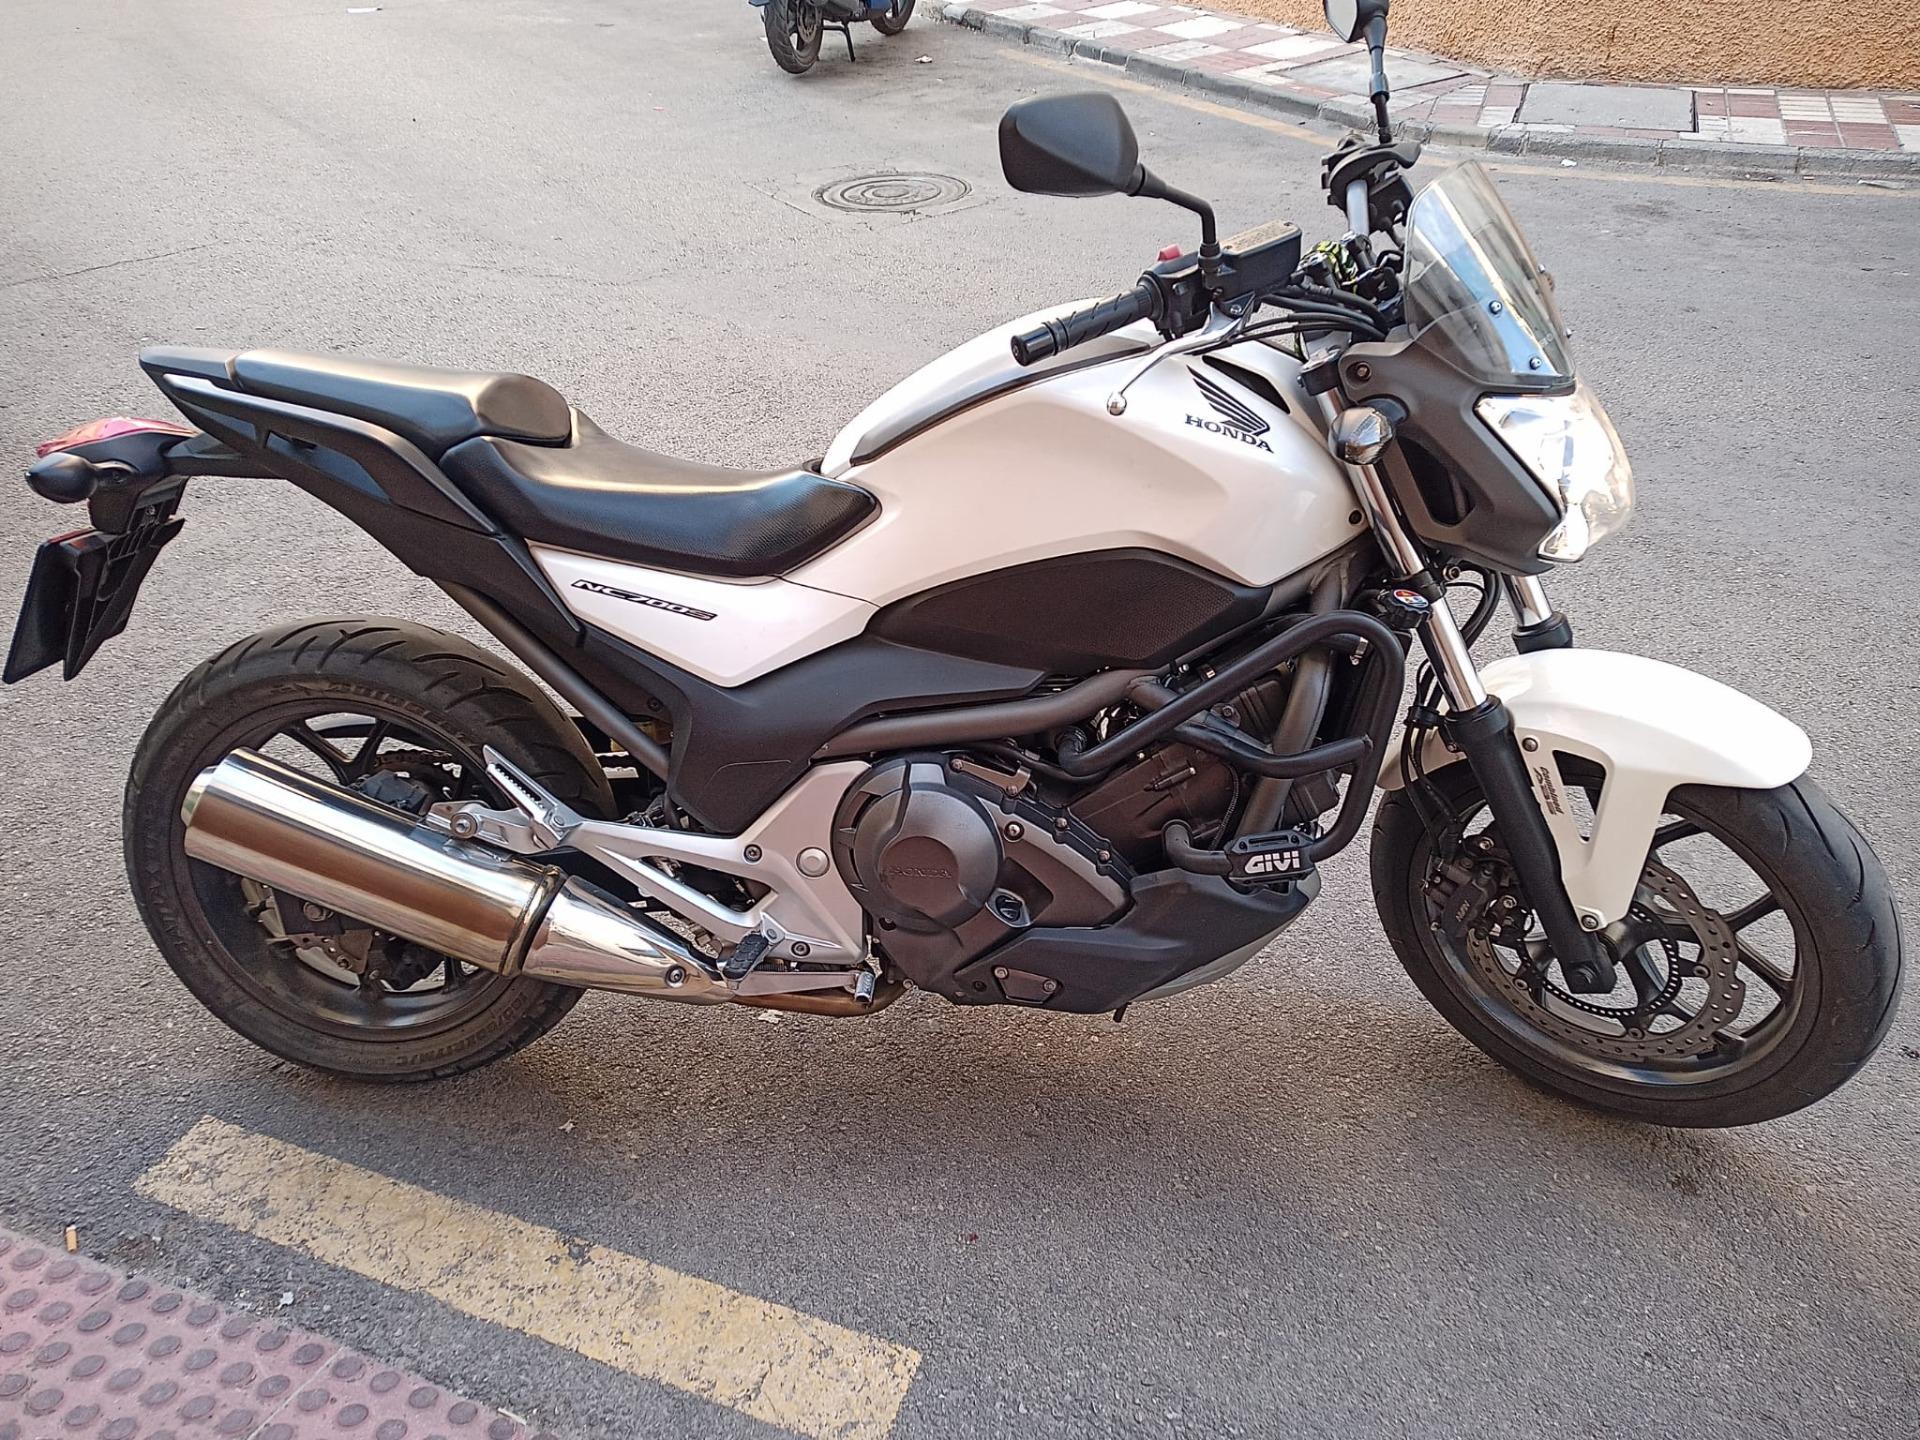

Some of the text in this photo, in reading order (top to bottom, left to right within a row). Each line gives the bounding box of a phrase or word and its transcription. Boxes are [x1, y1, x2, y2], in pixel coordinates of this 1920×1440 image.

[1185, 414, 1275, 454] HONDA
[571, 579, 718, 621] NC700S
[1244, 850, 1300, 874] GIVI
